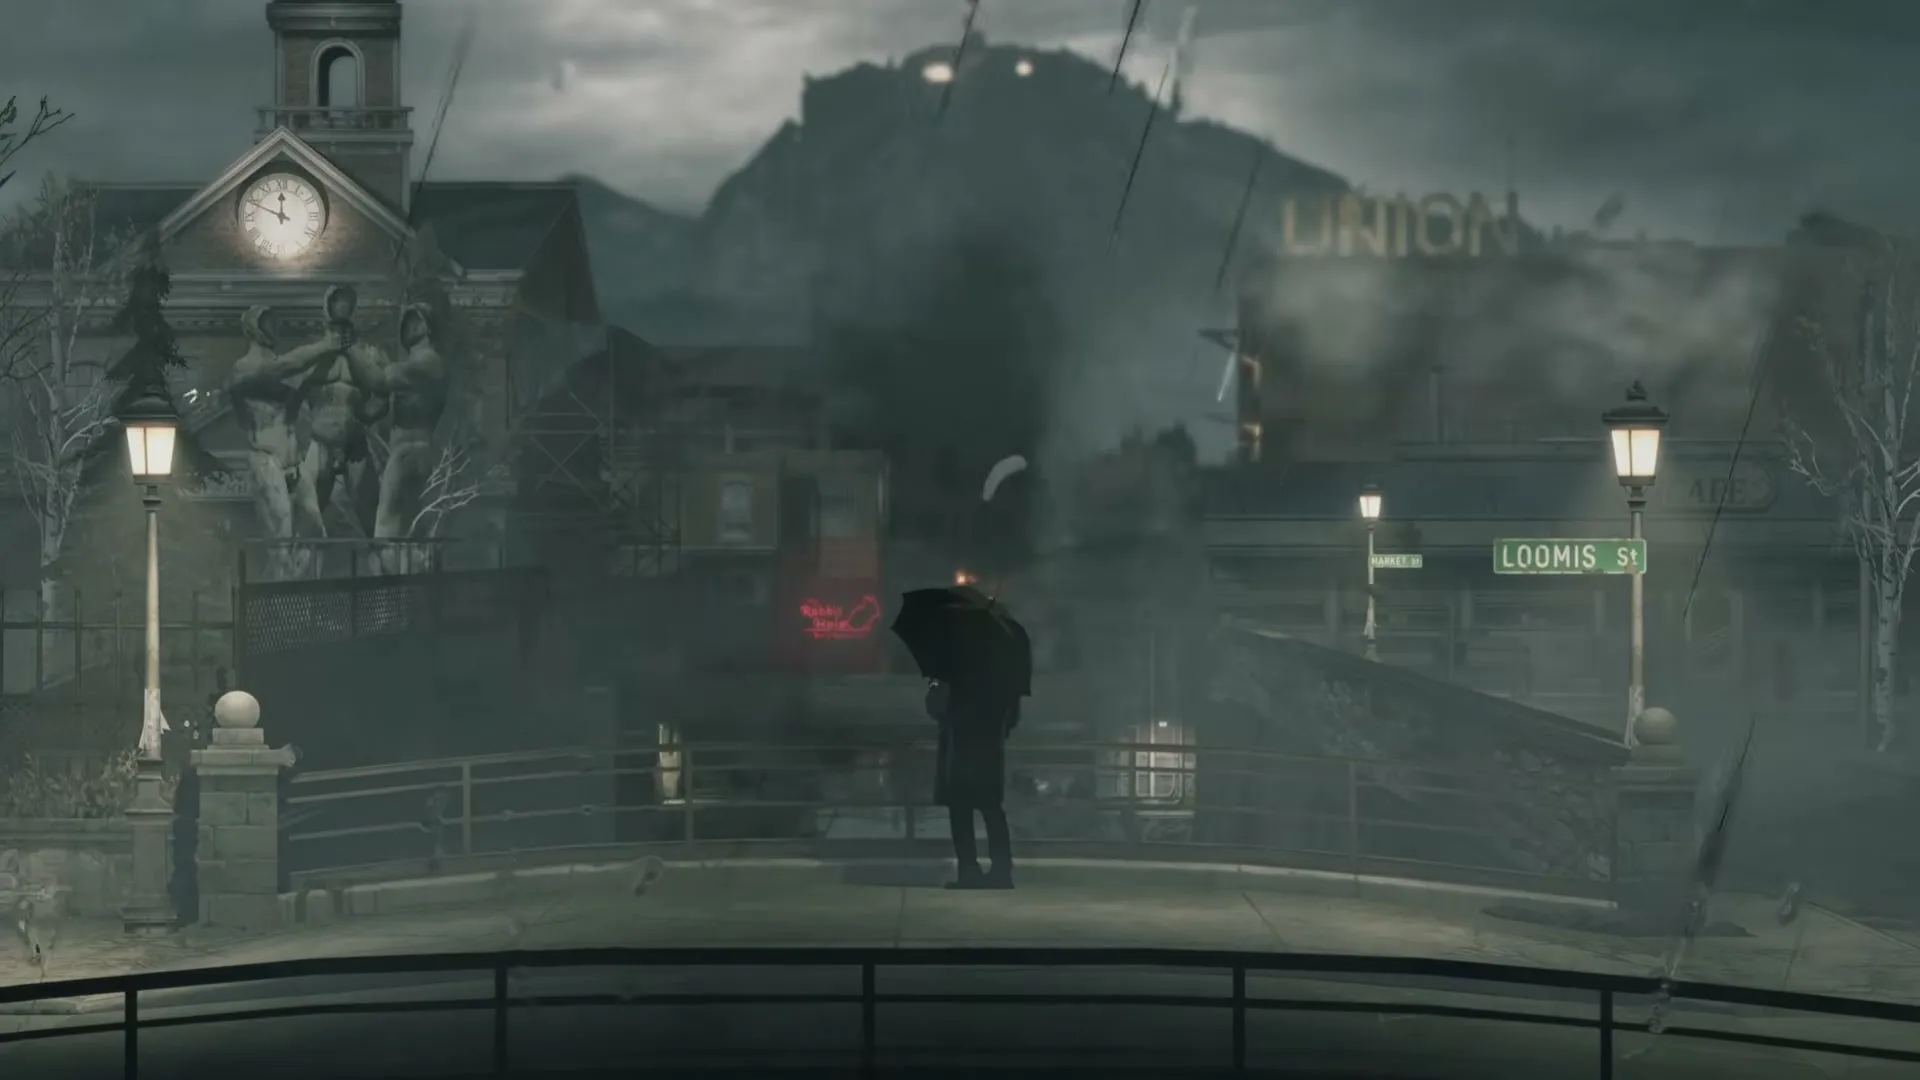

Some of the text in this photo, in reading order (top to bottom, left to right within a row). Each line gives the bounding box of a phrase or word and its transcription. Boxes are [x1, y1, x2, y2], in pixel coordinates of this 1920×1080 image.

[1282, 190, 1519, 258] UNION
[1371, 556, 1406, 565] MARKET
[1502, 544, 1638, 568] LOOMIS St
